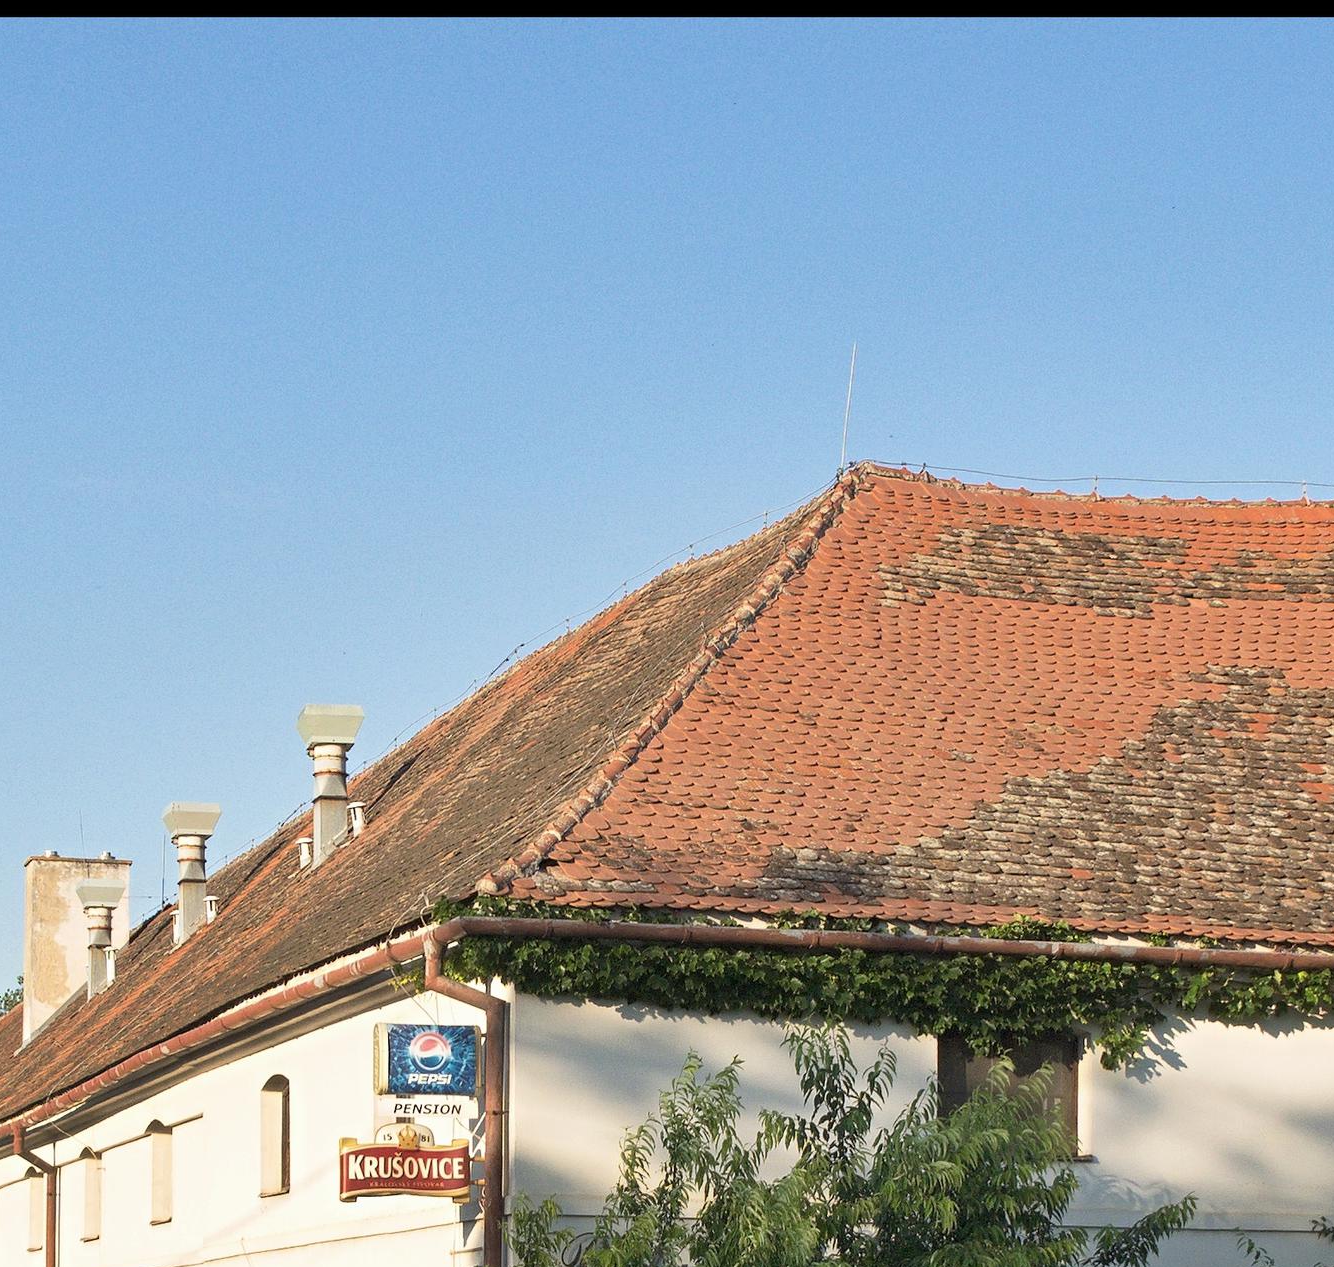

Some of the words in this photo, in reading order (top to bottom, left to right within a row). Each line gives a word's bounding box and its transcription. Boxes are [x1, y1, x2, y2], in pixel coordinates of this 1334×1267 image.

[408, 1073, 452, 1085] PEPSI
[393, 1103, 462, 1115] PENSION
[383, 1133, 393, 1141] 15
[348, 1152, 465, 1180] KRUŠOVICE
